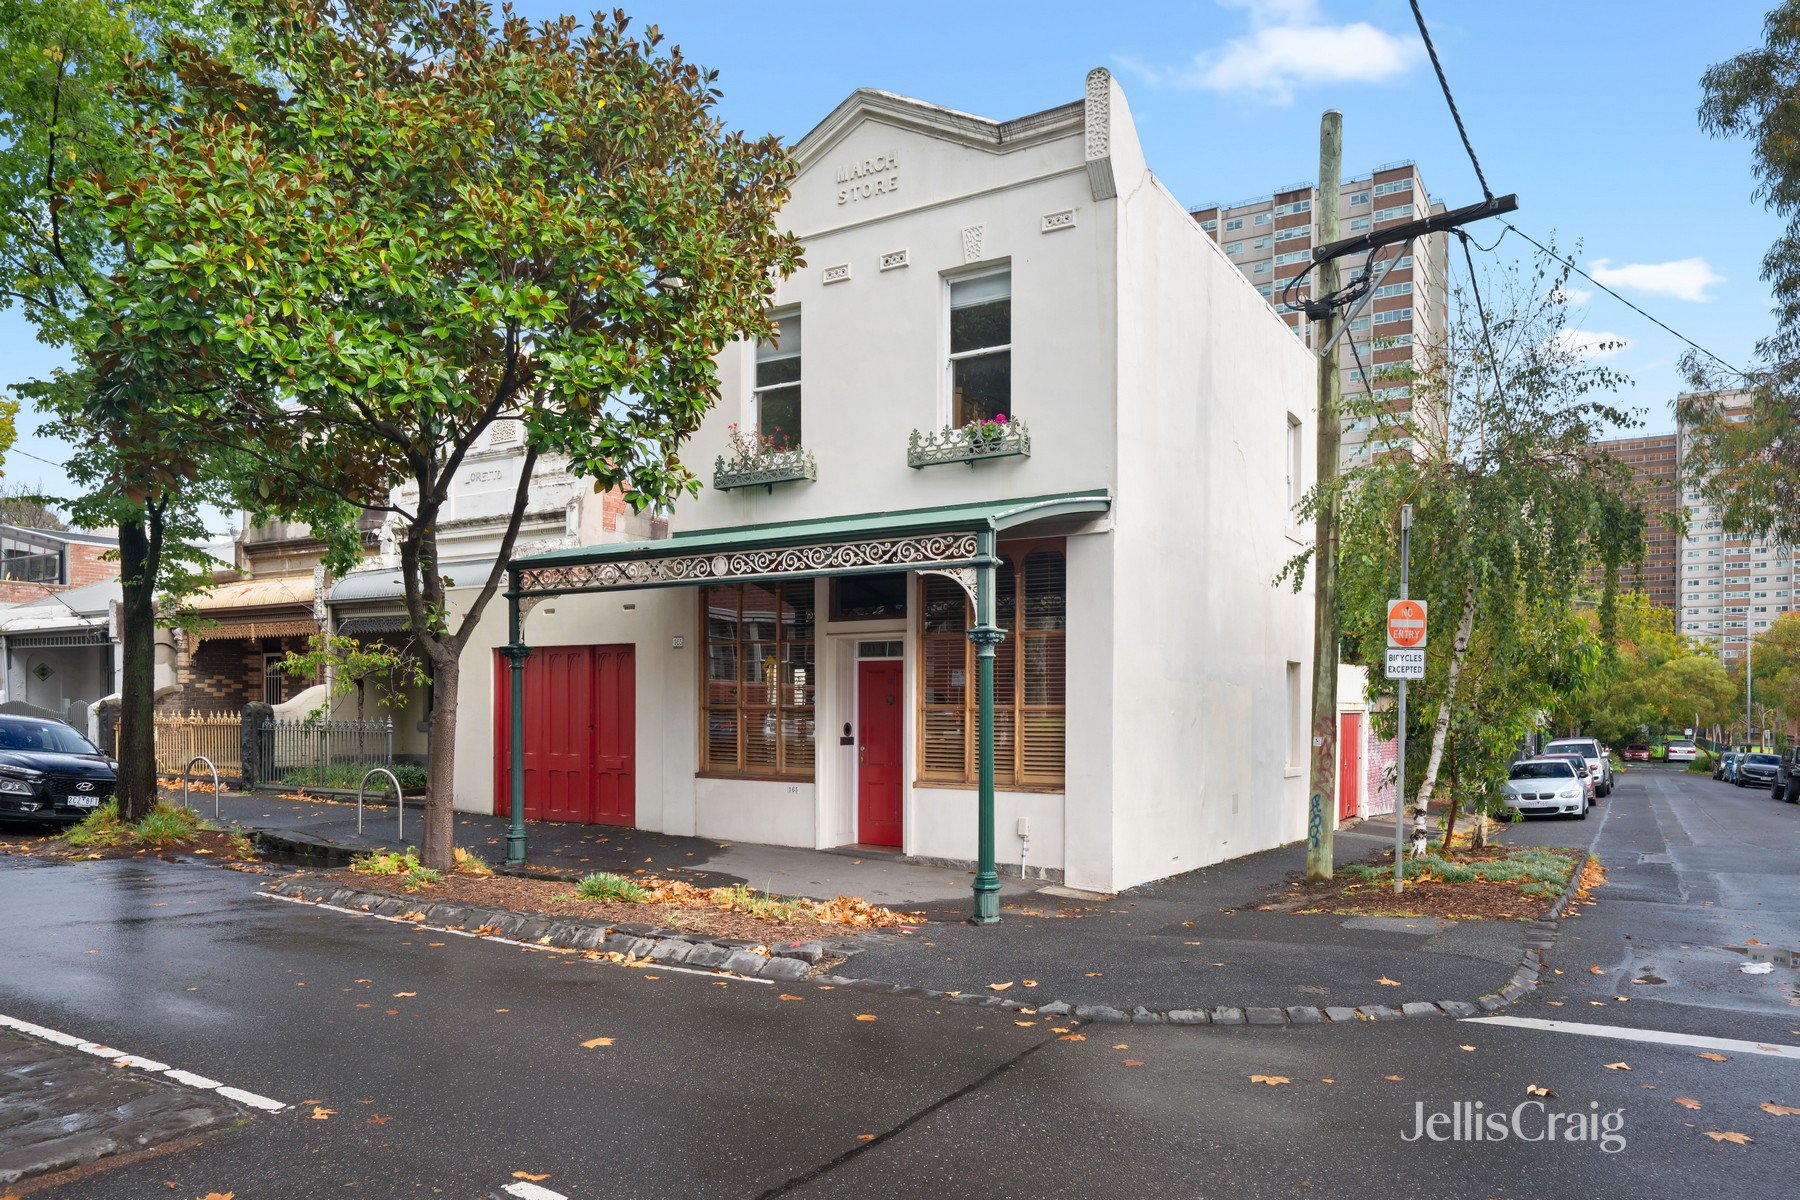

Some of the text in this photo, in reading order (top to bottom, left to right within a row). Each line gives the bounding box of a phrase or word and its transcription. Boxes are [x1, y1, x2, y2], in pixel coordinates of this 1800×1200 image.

[836, 150, 898, 184] MARCH
[837, 177, 898, 206] STORE
[1401, 607, 1413, 617] NO
[1393, 629, 1420, 639] ENTRY
[1388, 654, 1423, 662] BICYCLES
[1388, 665, 1423, 674] EXCEPTED
